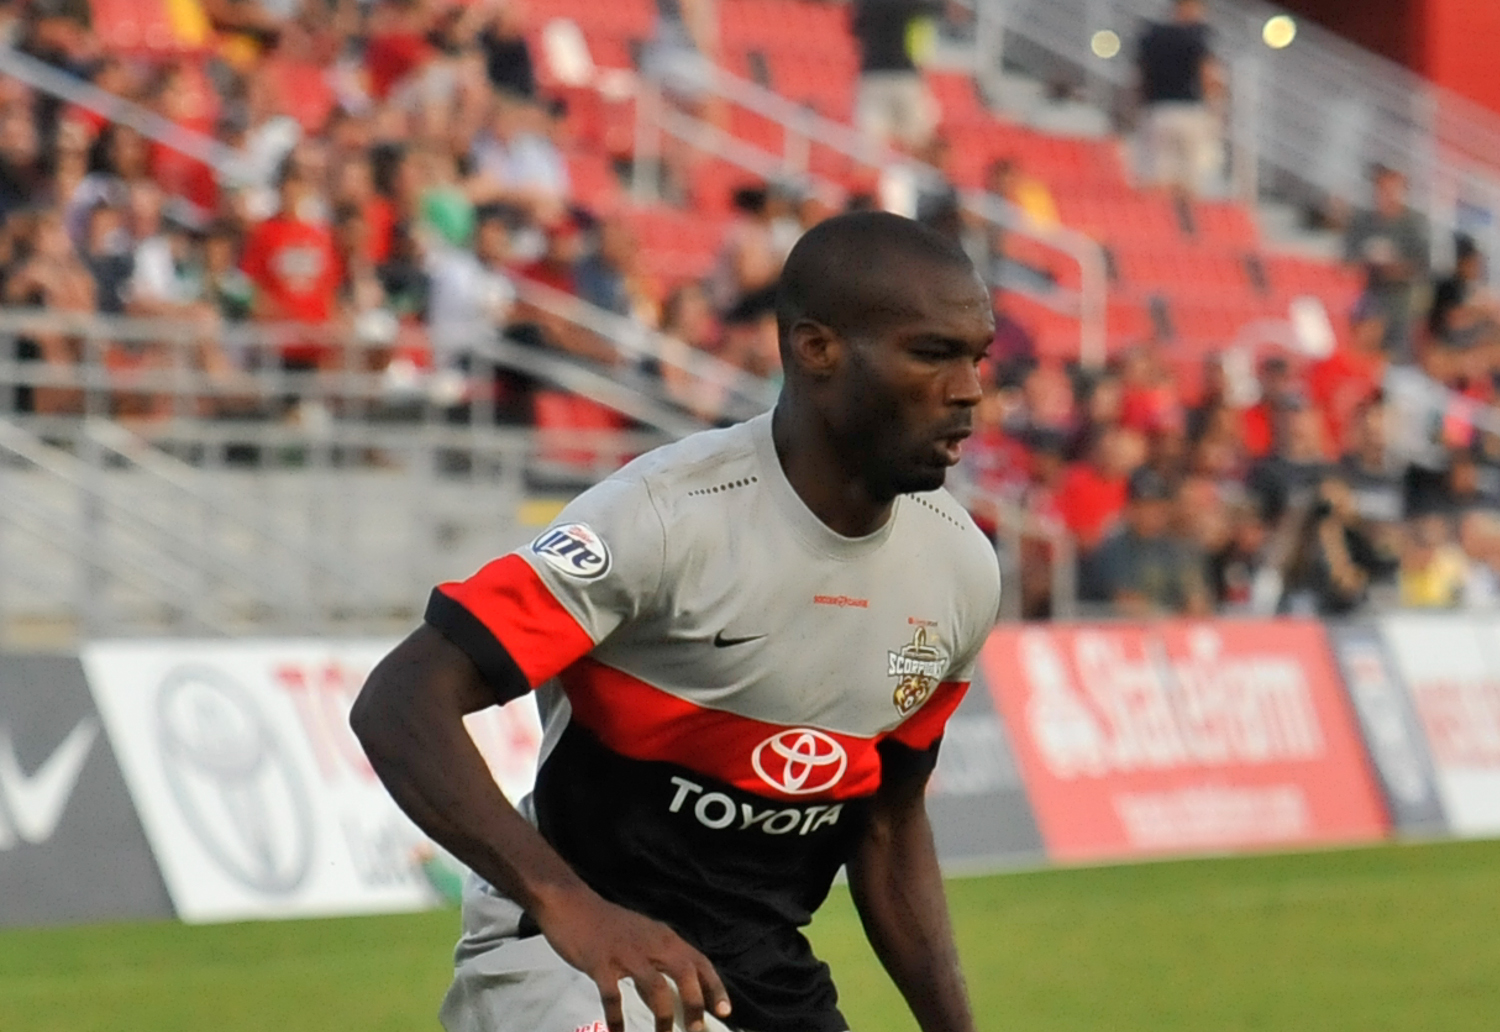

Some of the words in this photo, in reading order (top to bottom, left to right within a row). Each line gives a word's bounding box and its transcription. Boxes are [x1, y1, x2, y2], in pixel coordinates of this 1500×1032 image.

[532, 530, 602, 570] Lite
[887, 650, 948, 681] SCORPIONS
[669, 775, 844, 835] TOYOTA
